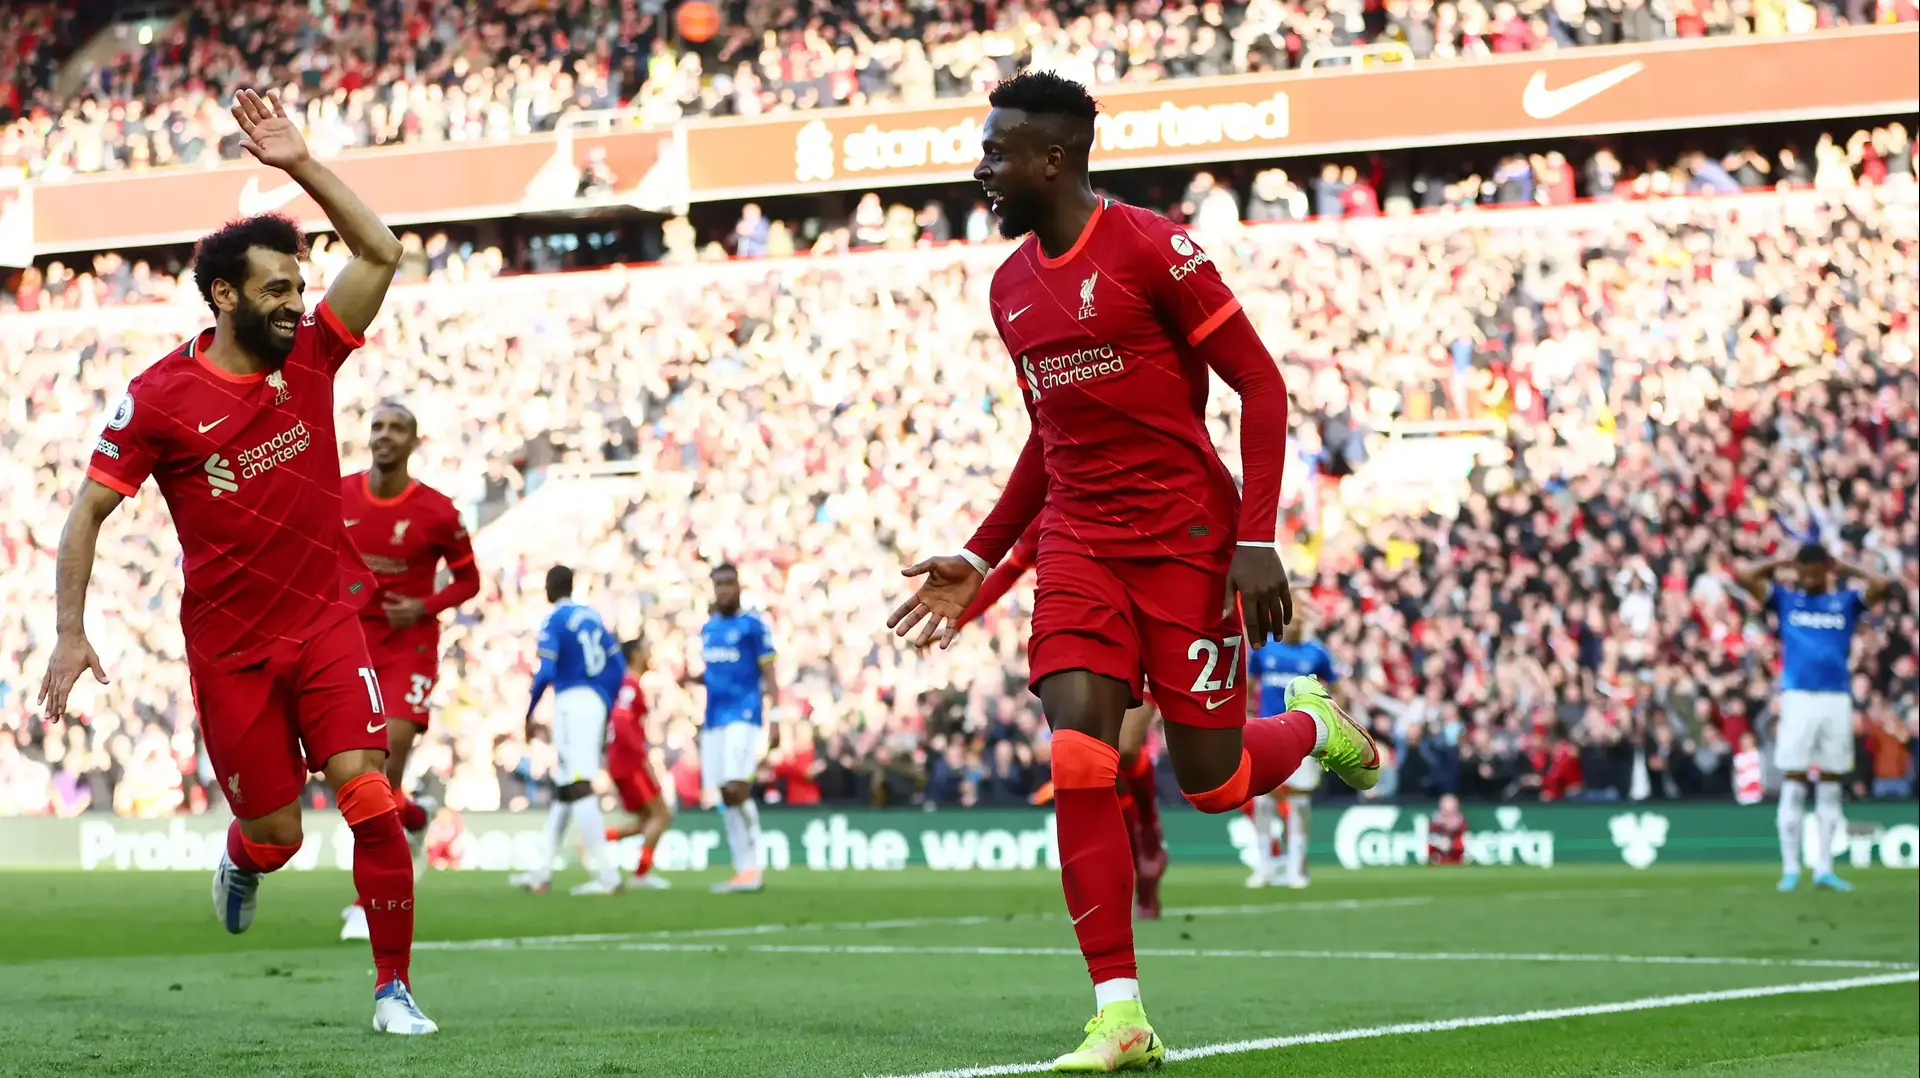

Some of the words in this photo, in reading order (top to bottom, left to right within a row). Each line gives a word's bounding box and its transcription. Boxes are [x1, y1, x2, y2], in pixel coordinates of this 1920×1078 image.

[843, 117, 985, 172] stand
[1089, 91, 1289, 151] hartered
[1039, 344, 1113, 373] standard
[1042, 356, 1124, 389] chartered
[237, 420, 306, 466] standard
[242, 431, 310, 479] chartered
[1188, 635, 1242, 692] 27
[802, 814, 910, 871] the
[920, 813, 1062, 871] worl
[1335, 805, 1553, 869] Carlerg
